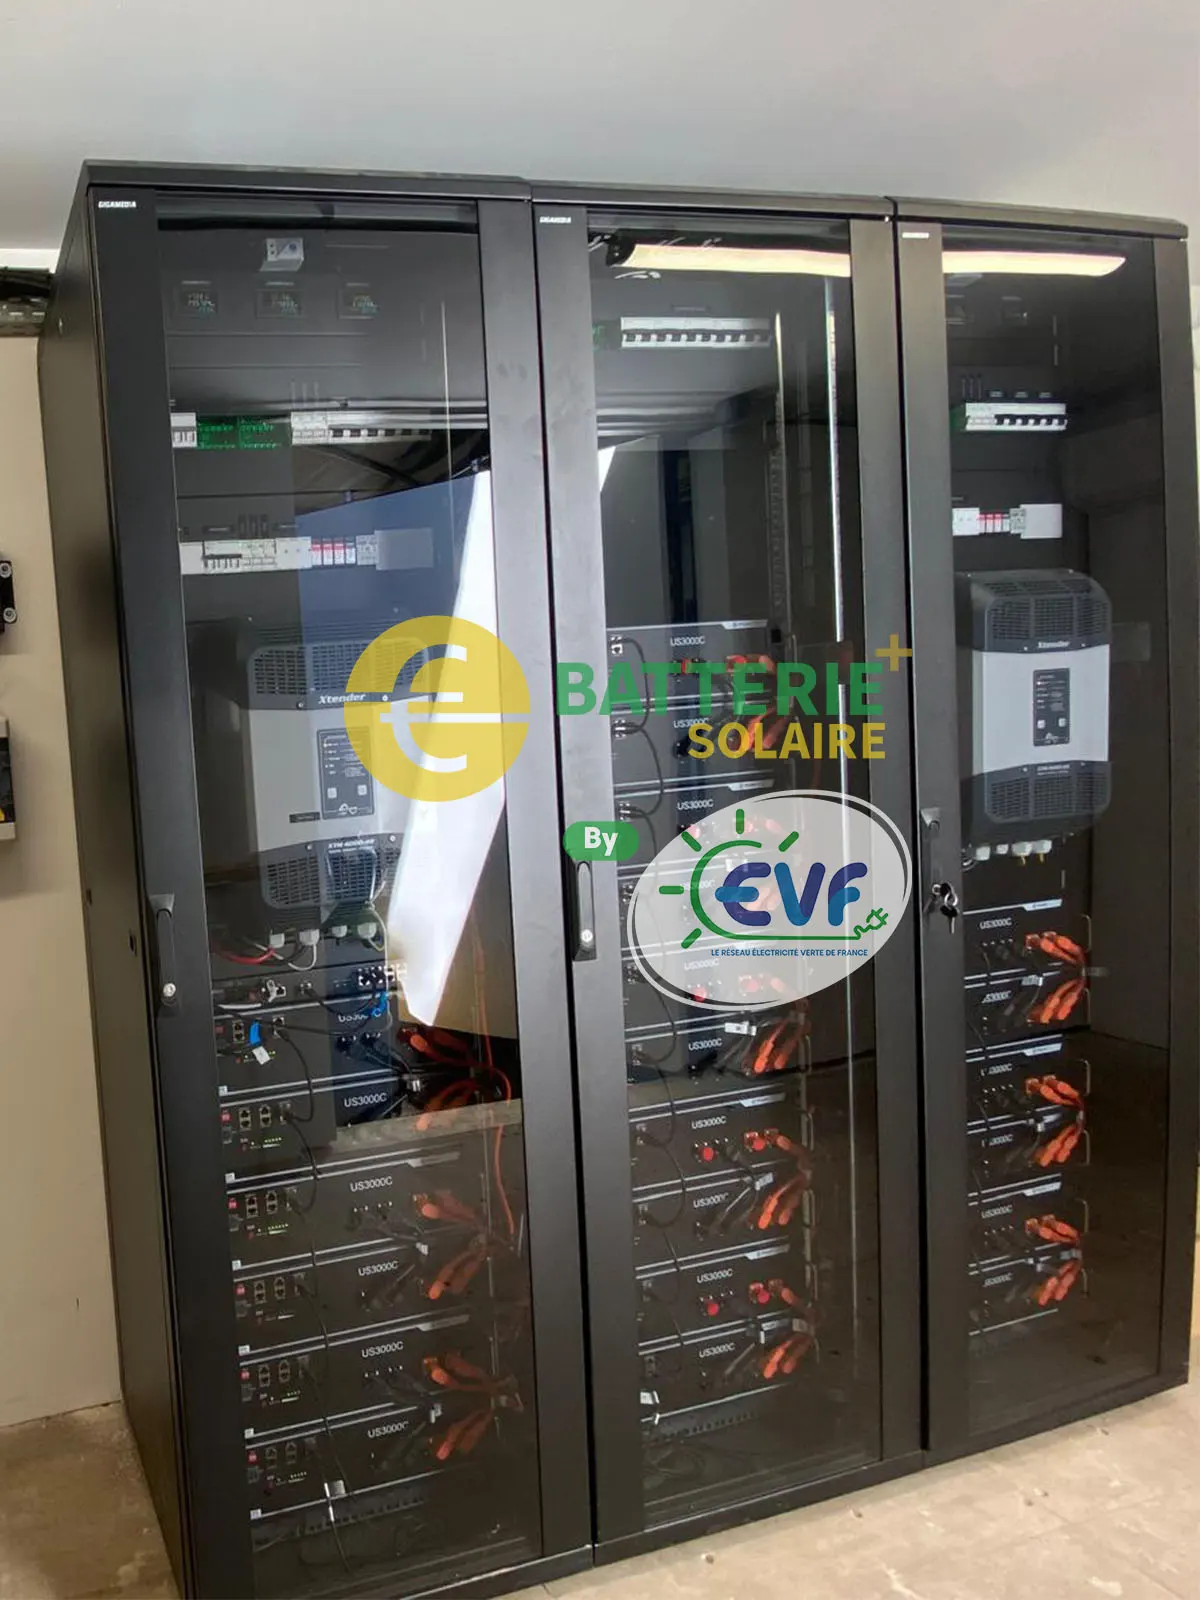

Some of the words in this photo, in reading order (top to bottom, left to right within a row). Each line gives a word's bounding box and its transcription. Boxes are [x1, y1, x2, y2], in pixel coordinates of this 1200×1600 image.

[669, 634, 706, 647] US3000C
[318, 692, 366, 705] Xtender
[677, 798, 714, 811] US3000C
[688, 1037, 723, 1051] US3000C
[344, 1092, 387, 1108] US3000C
[691, 1115, 727, 1130] US3000C
[350, 1175, 393, 1192] US3000C
[358, 1260, 399, 1276] US3000C
[696, 1268, 733, 1283] US3000C
[362, 1341, 404, 1358] US3000C
[699, 1342, 736, 1358] US3000C
[367, 1421, 409, 1438] US3000C
